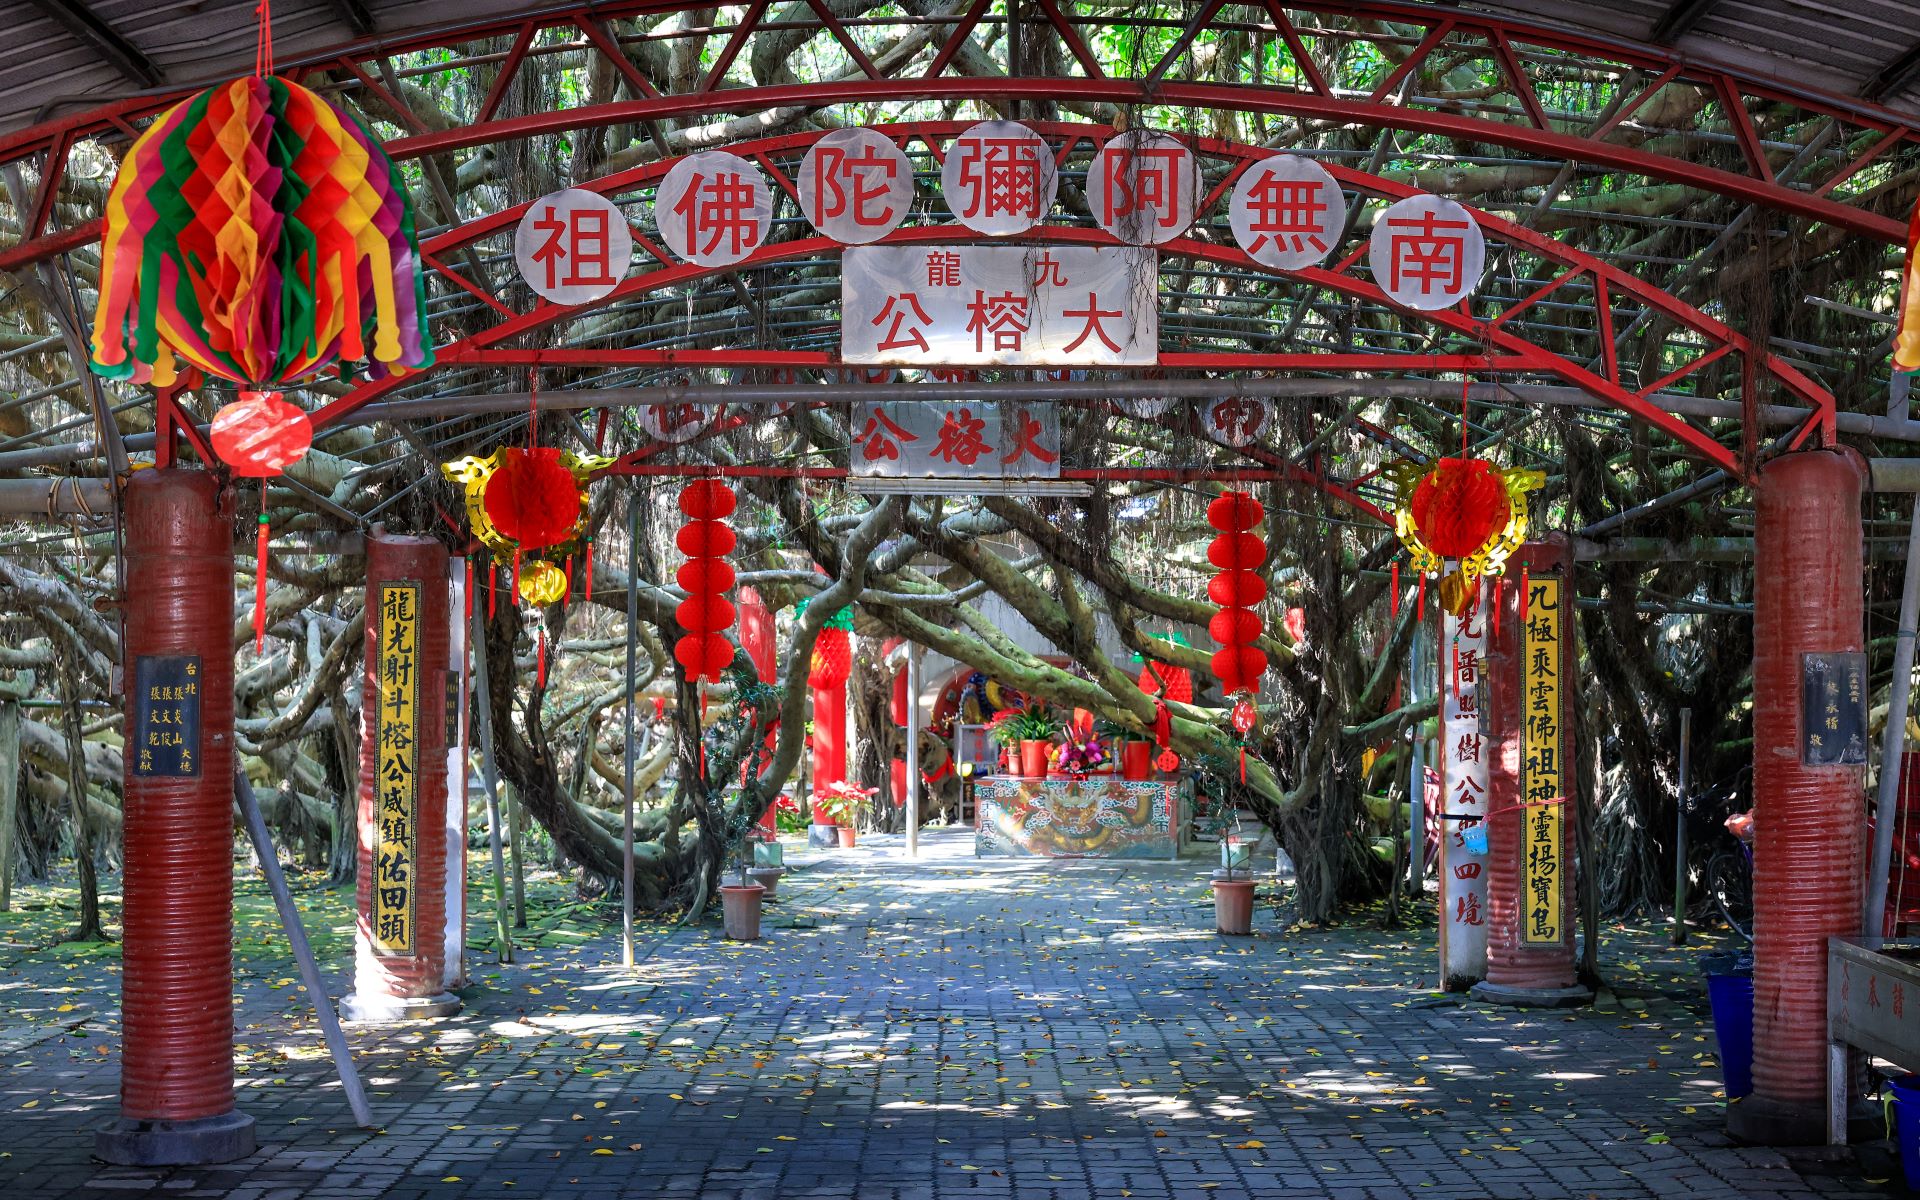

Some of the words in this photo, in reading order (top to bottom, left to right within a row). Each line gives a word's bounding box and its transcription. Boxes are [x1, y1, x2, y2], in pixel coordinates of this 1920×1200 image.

[532, 138, 1469, 295] 南無阿彌陀佛祖
[926, 250, 1069, 287] 九龍
[871, 289, 1124, 354] 大榕公
[852, 407, 1060, 466] 大榕公
[184, 662, 198, 695] 台北
